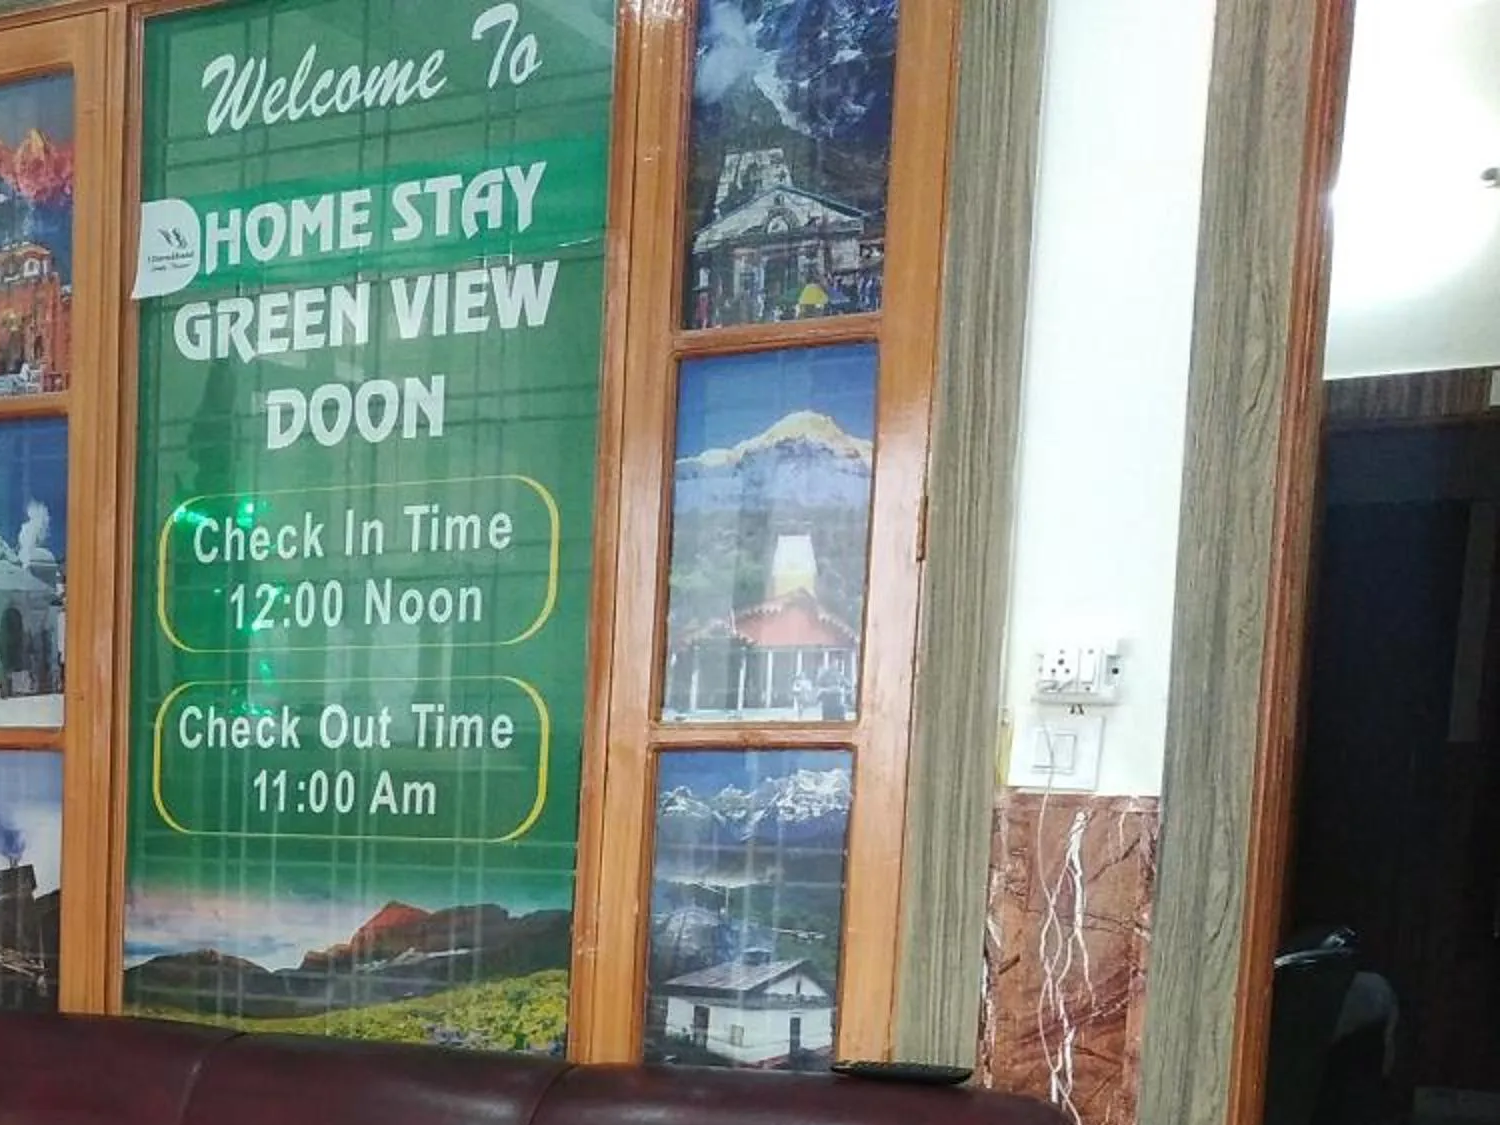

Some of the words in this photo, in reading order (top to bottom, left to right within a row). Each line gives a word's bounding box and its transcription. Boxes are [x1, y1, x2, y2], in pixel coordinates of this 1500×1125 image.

[202, 44, 448, 135] Welcome
[472, 4, 543, 88] To
[206, 188, 372, 275] HOME
[392, 161, 547, 241] STAY
[173, 282, 369, 364] GREEN
[390, 260, 559, 340] VIEW
[267, 374, 444, 449] DOON
[194, 512, 323, 563] Check
[345, 509, 383, 555] In
[403, 505, 513, 552] Time
[230, 580, 342, 630] 12:00
[365, 579, 482, 624] Noon
[179, 705, 300, 749] Check
[319, 704, 392, 748] Out
[411, 704, 513, 749] Time
[253, 770, 355, 813] 11:00
[370, 771, 436, 815] Am
